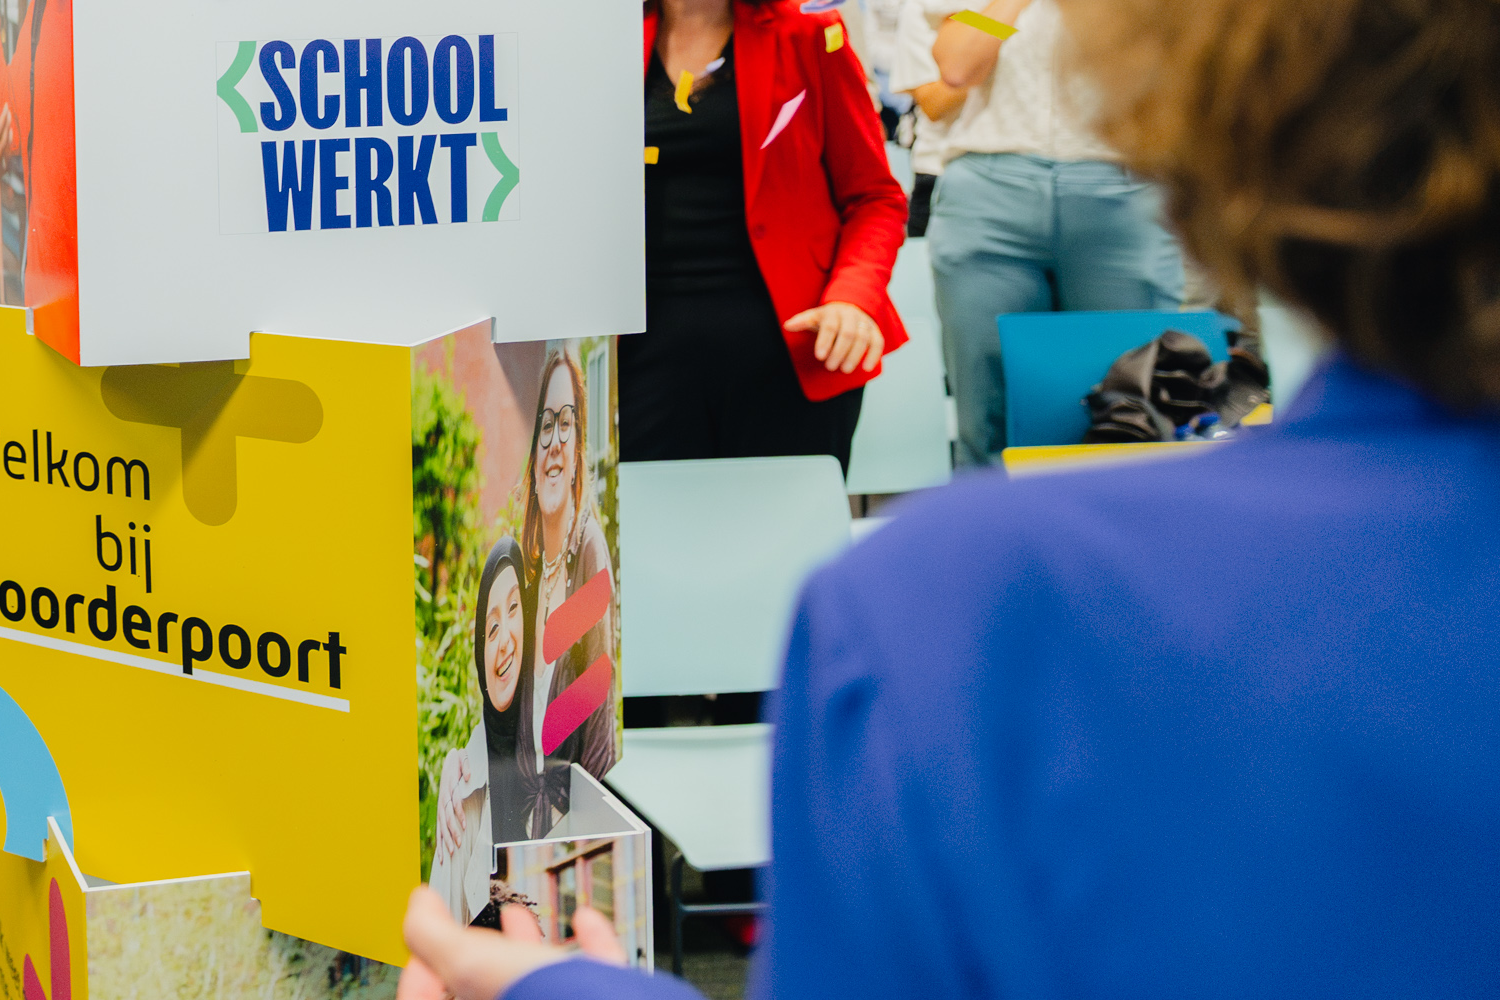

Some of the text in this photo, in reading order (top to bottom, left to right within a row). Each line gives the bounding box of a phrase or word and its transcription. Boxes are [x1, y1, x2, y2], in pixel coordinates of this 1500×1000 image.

[258, 34, 509, 132] SCHOOL
[260, 132, 478, 233] WERKT
[95, 514, 152, 594] bij
